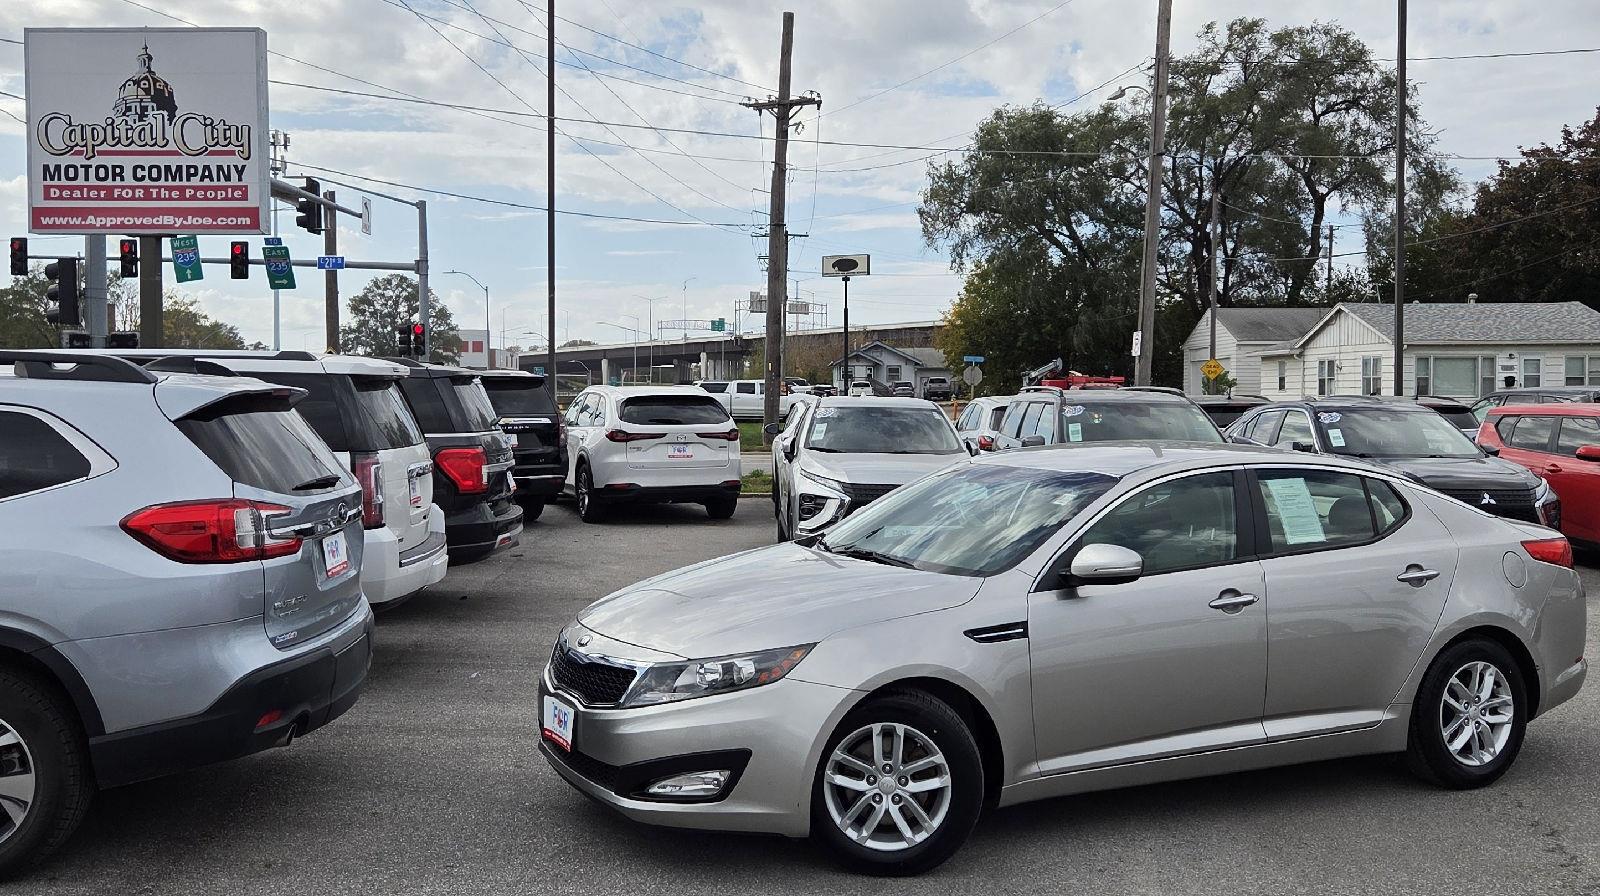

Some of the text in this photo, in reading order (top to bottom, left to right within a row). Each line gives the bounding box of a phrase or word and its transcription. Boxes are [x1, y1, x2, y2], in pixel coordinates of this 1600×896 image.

[37, 111, 252, 160] Capital City
[43, 164, 247, 182] MOTOR COMPANY
[50, 187, 107, 198] Dealer
[113, 188, 144, 198] FOR
[150, 187, 180, 198] The
[41, 215, 251, 227] www.ApprovedByJoe.com
[178, 253, 196, 263] 235
[270, 262, 288, 271] 235
